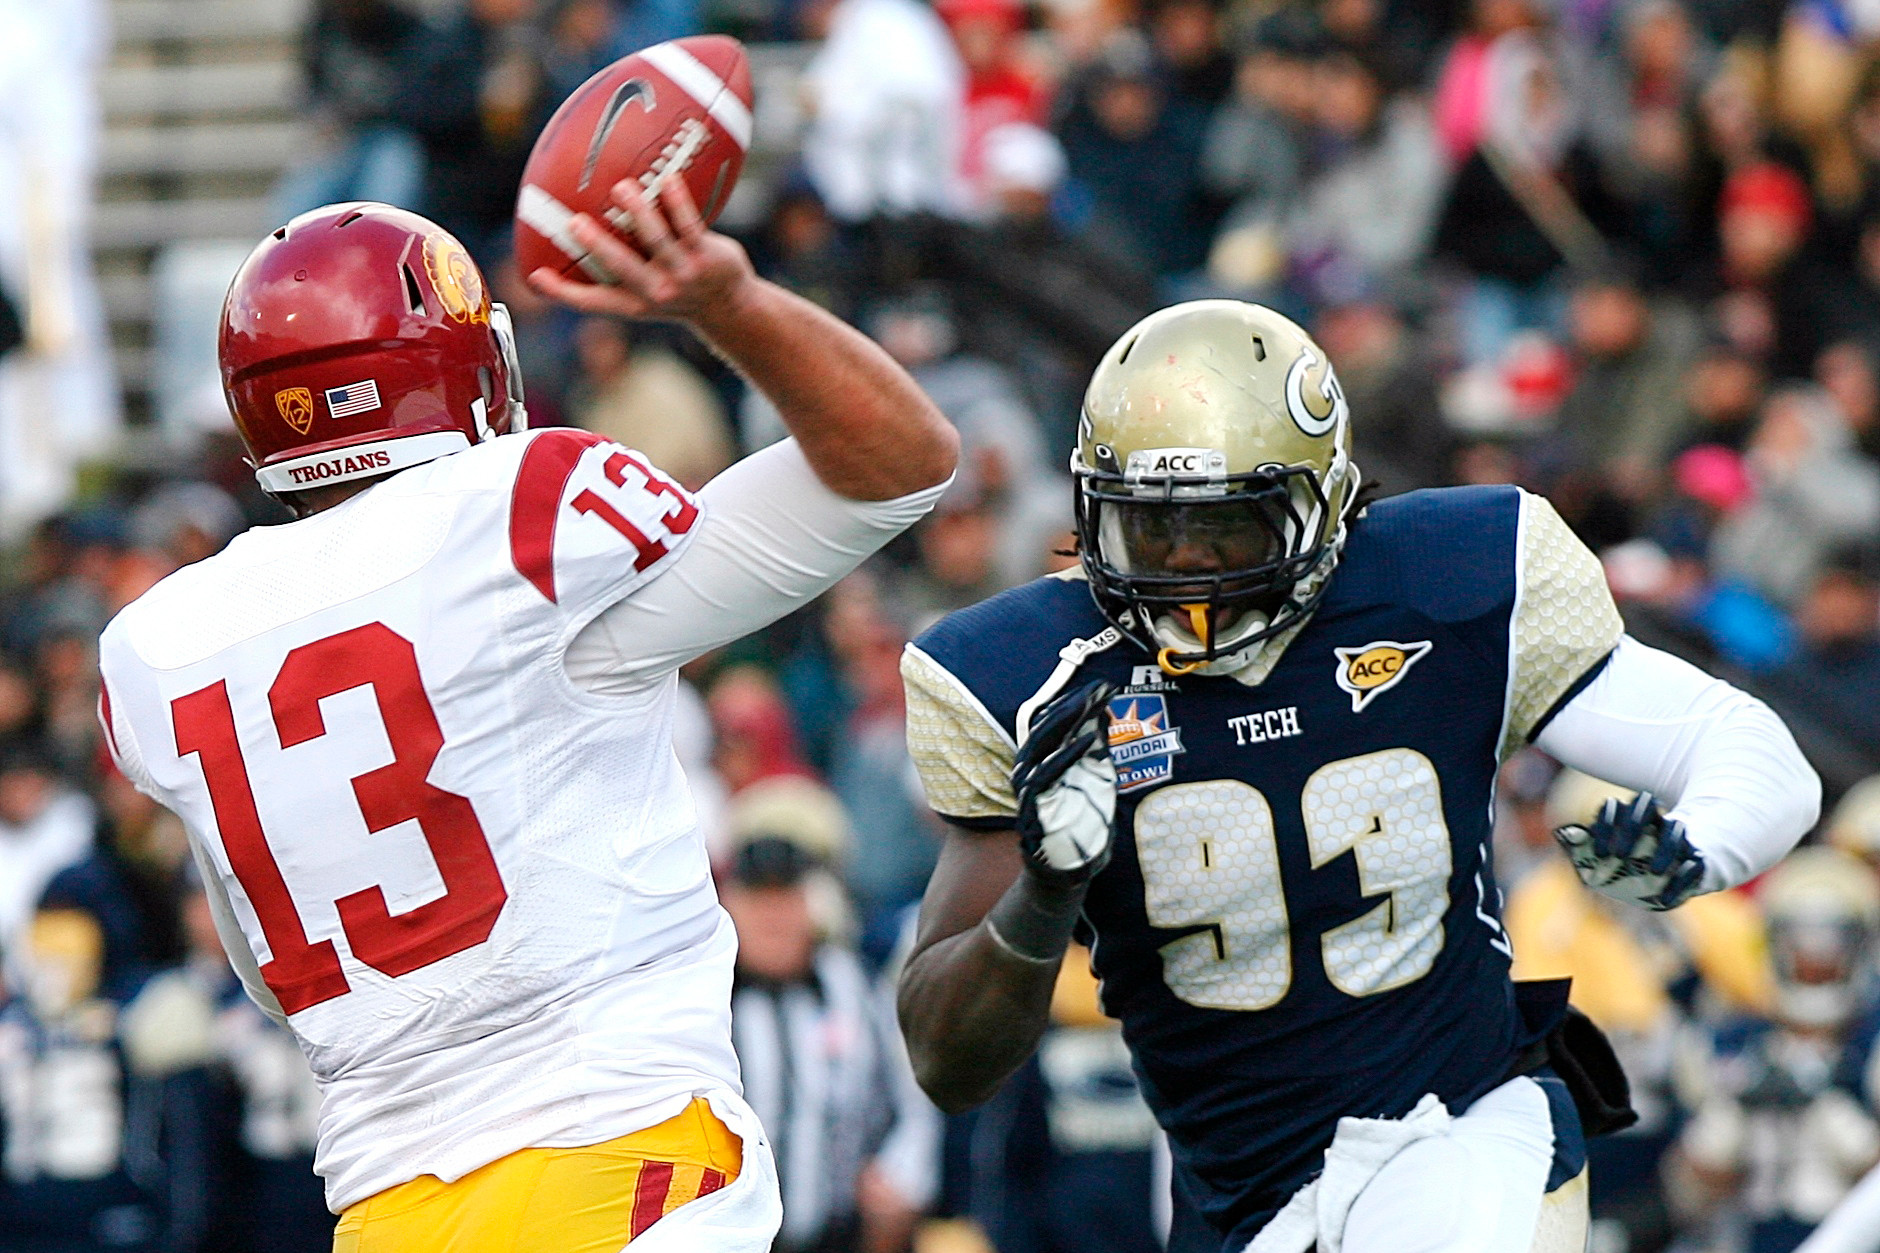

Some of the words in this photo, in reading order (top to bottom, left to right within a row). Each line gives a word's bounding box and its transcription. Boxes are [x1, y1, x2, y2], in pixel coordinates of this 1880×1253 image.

[278, 390, 310, 418] PAC
[289, 408, 308, 425] 12
[289, 451, 390, 484] TROJANS
[1153, 455, 1197, 471] ACC
[570, 452, 699, 573] 13
[1352, 656, 1398, 680] ACC
[1227, 706, 1303, 746] TECH
[1111, 737, 1168, 760] YUNDAI
[170, 621, 508, 1017] 13
[1133, 747, 1452, 1012] 93
